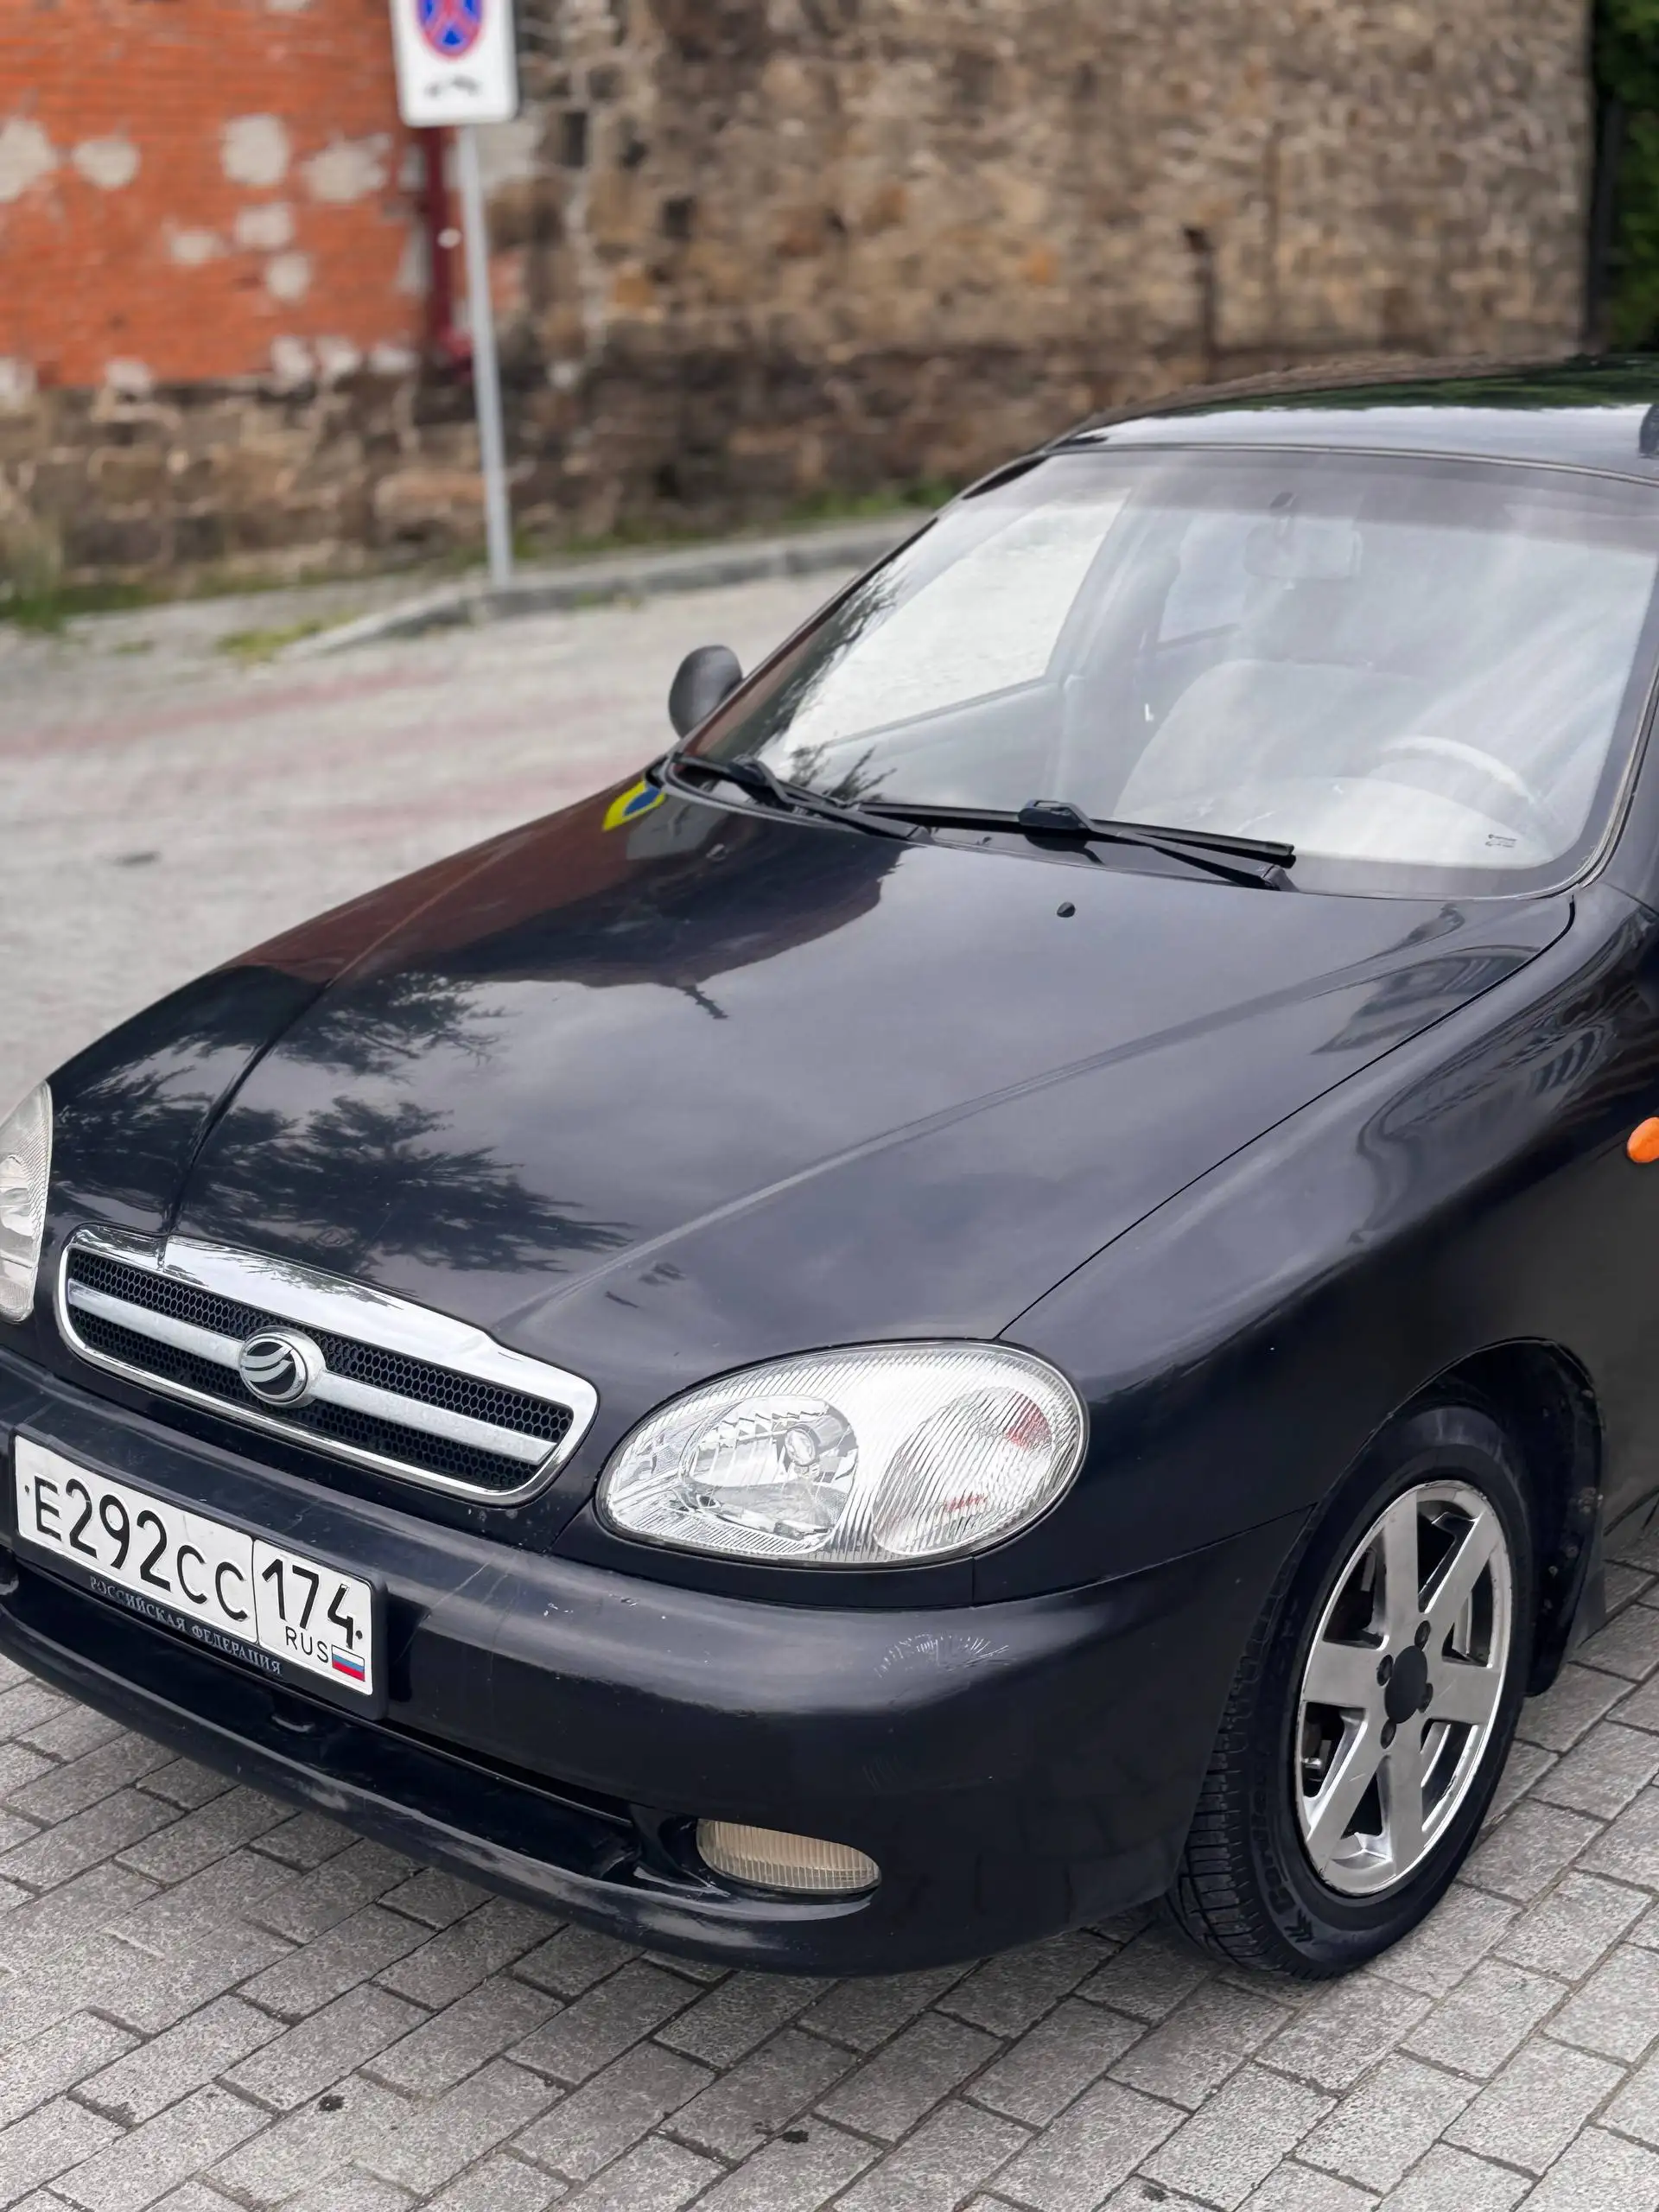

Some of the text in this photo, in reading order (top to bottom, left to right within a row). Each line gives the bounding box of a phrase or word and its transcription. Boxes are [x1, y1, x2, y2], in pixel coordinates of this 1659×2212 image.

[90, 1575, 282, 1675] РОССИЙСКАЯ ФЕДЕРАЦИЯ
[262, 1559, 353, 1649] 174
[285, 1625, 329, 1663] RUS
